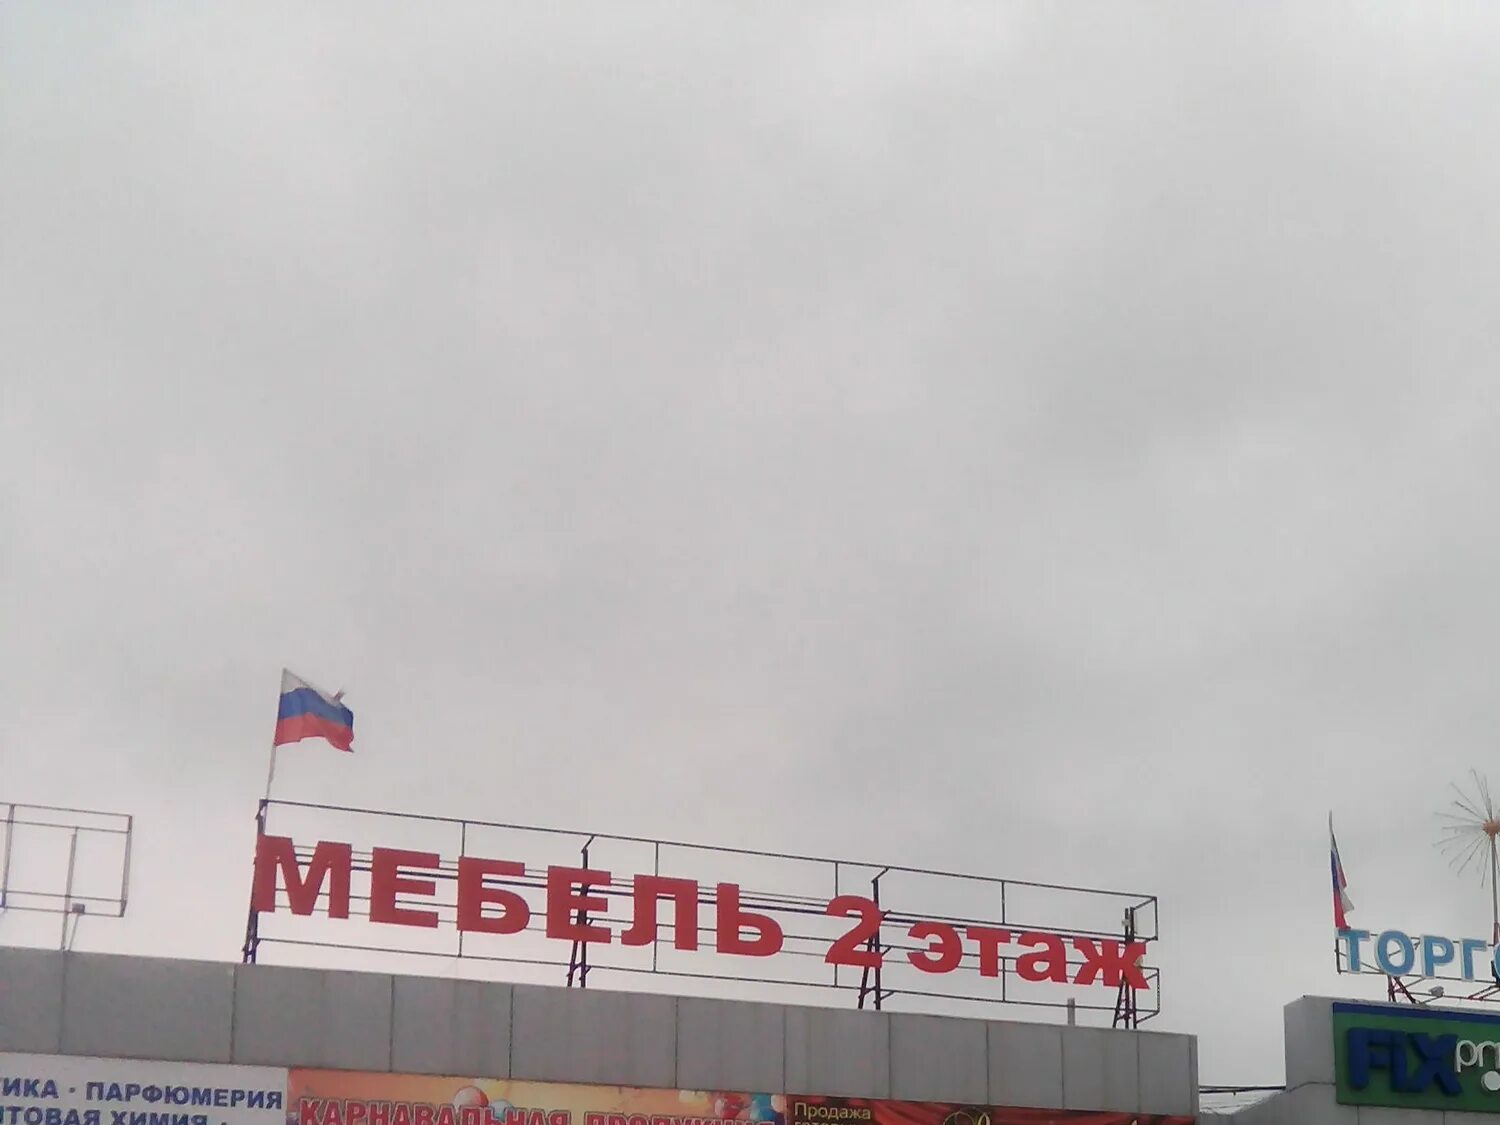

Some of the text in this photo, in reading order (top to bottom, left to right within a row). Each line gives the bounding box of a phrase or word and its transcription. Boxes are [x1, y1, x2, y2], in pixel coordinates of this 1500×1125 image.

[253, 834, 1151, 990] МЕБЕЛЬ 2 этаж
[0, 1077, 282, 1110] ИКА ПАРФЮМЕРИЯ
[794, 1102, 872, 1122] Продажа
